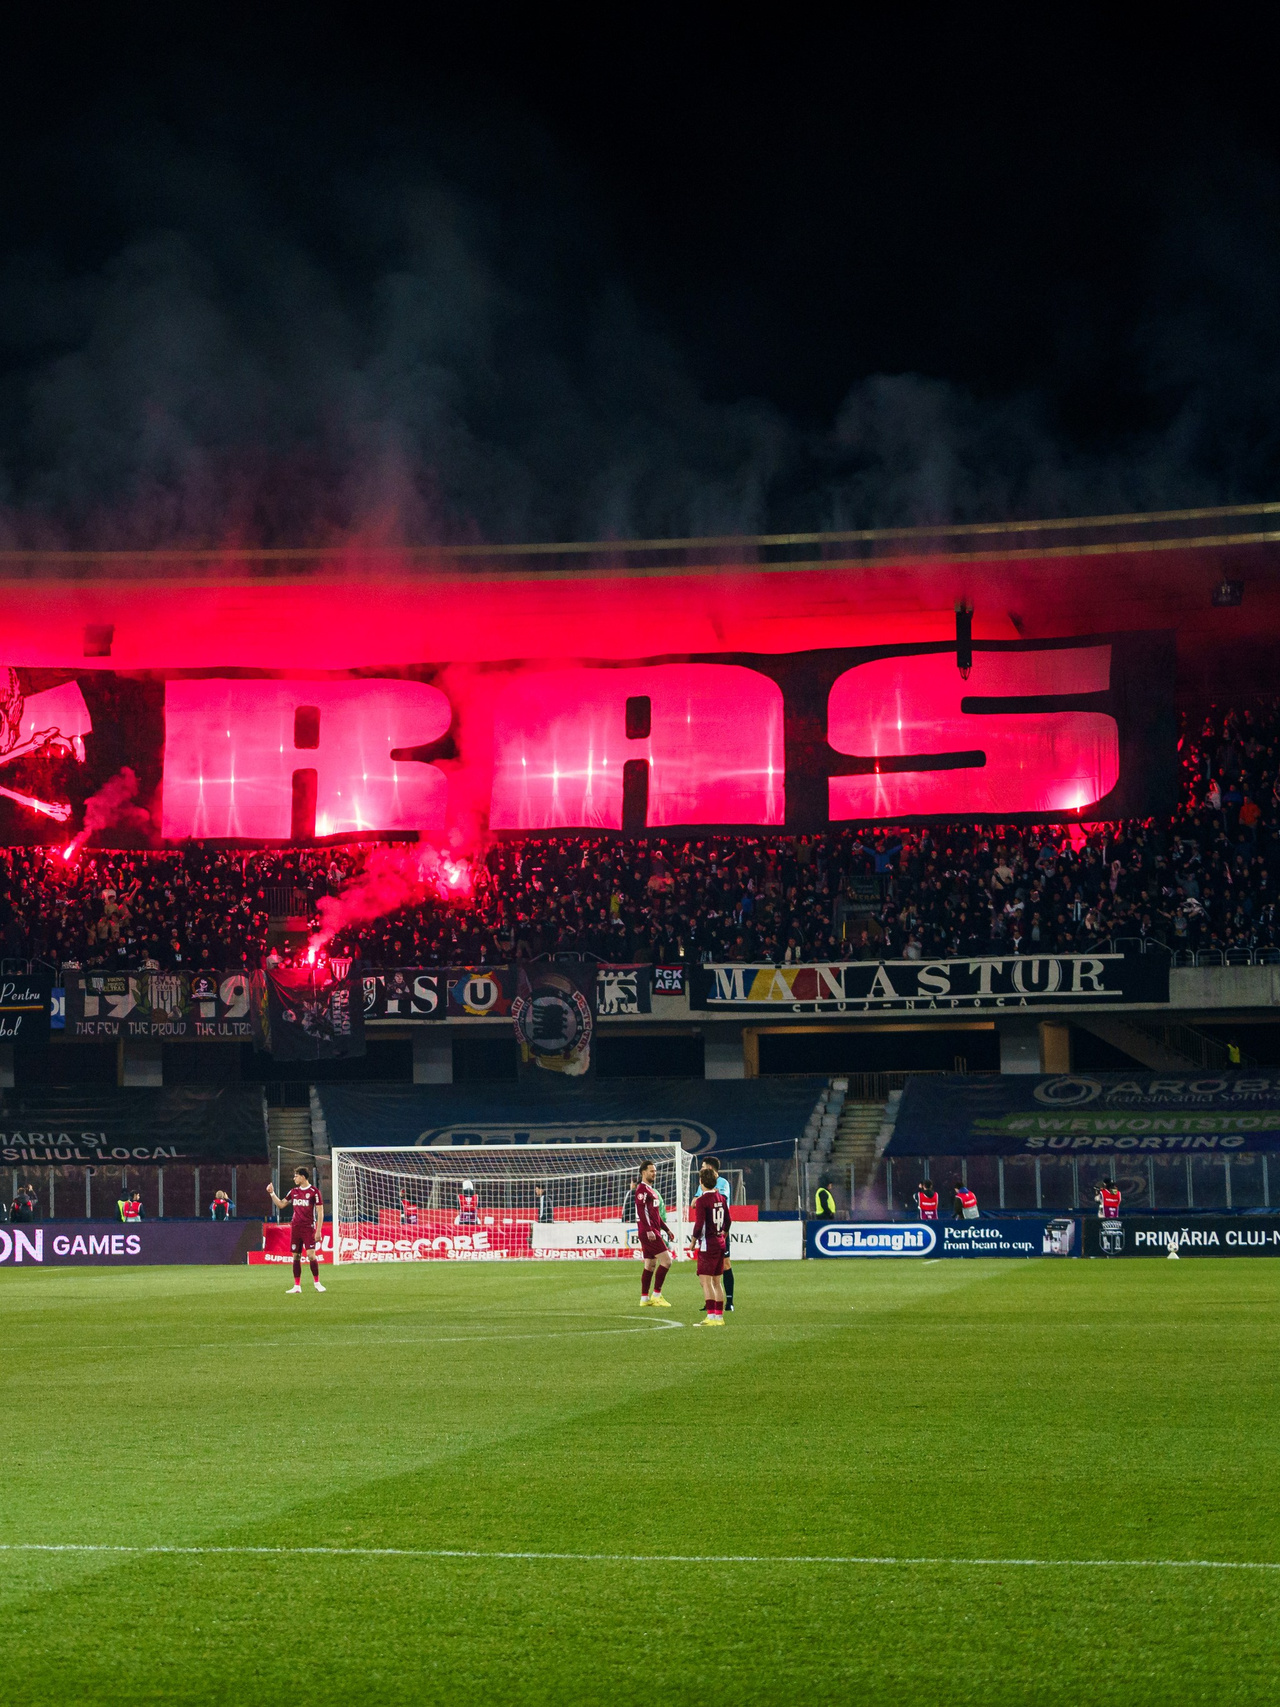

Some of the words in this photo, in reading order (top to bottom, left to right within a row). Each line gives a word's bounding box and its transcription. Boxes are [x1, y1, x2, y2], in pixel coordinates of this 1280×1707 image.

[655, 969, 683, 980] FCK
[655, 980, 682, 990] AFA
[0, 982, 44, 1004] Pentru
[76, 1022, 95, 1035] THE
[96, 1022, 120, 1035] FEW
[128, 1022, 148, 1035] THE
[151, 1022, 187, 1036] PROUD
[195, 1021, 216, 1036] THE
[1109, 1078, 1280, 1094] AROB
[1024, 1136, 1246, 1150] SUPPORTING
[96, 1145, 187, 1160] LOCAL
[577, 1234, 620, 1245] BANCA
[944, 1226, 1003, 1240] Perfetto,
[1135, 1227, 1220, 1246] PRIMĂRIA
[53, 1234, 141, 1256] GAMES
[944, 1239, 970, 1250] from
[972, 1240, 997, 1250] bean
[999, 1240, 1010, 1250] to
[1012, 1241, 1035, 1252] cup.
[353, 1251, 421, 1262] SUPERLIGA
[447, 1248, 509, 1260] SUPERBET
[534, 1248, 606, 1260] SUPERLIGA
